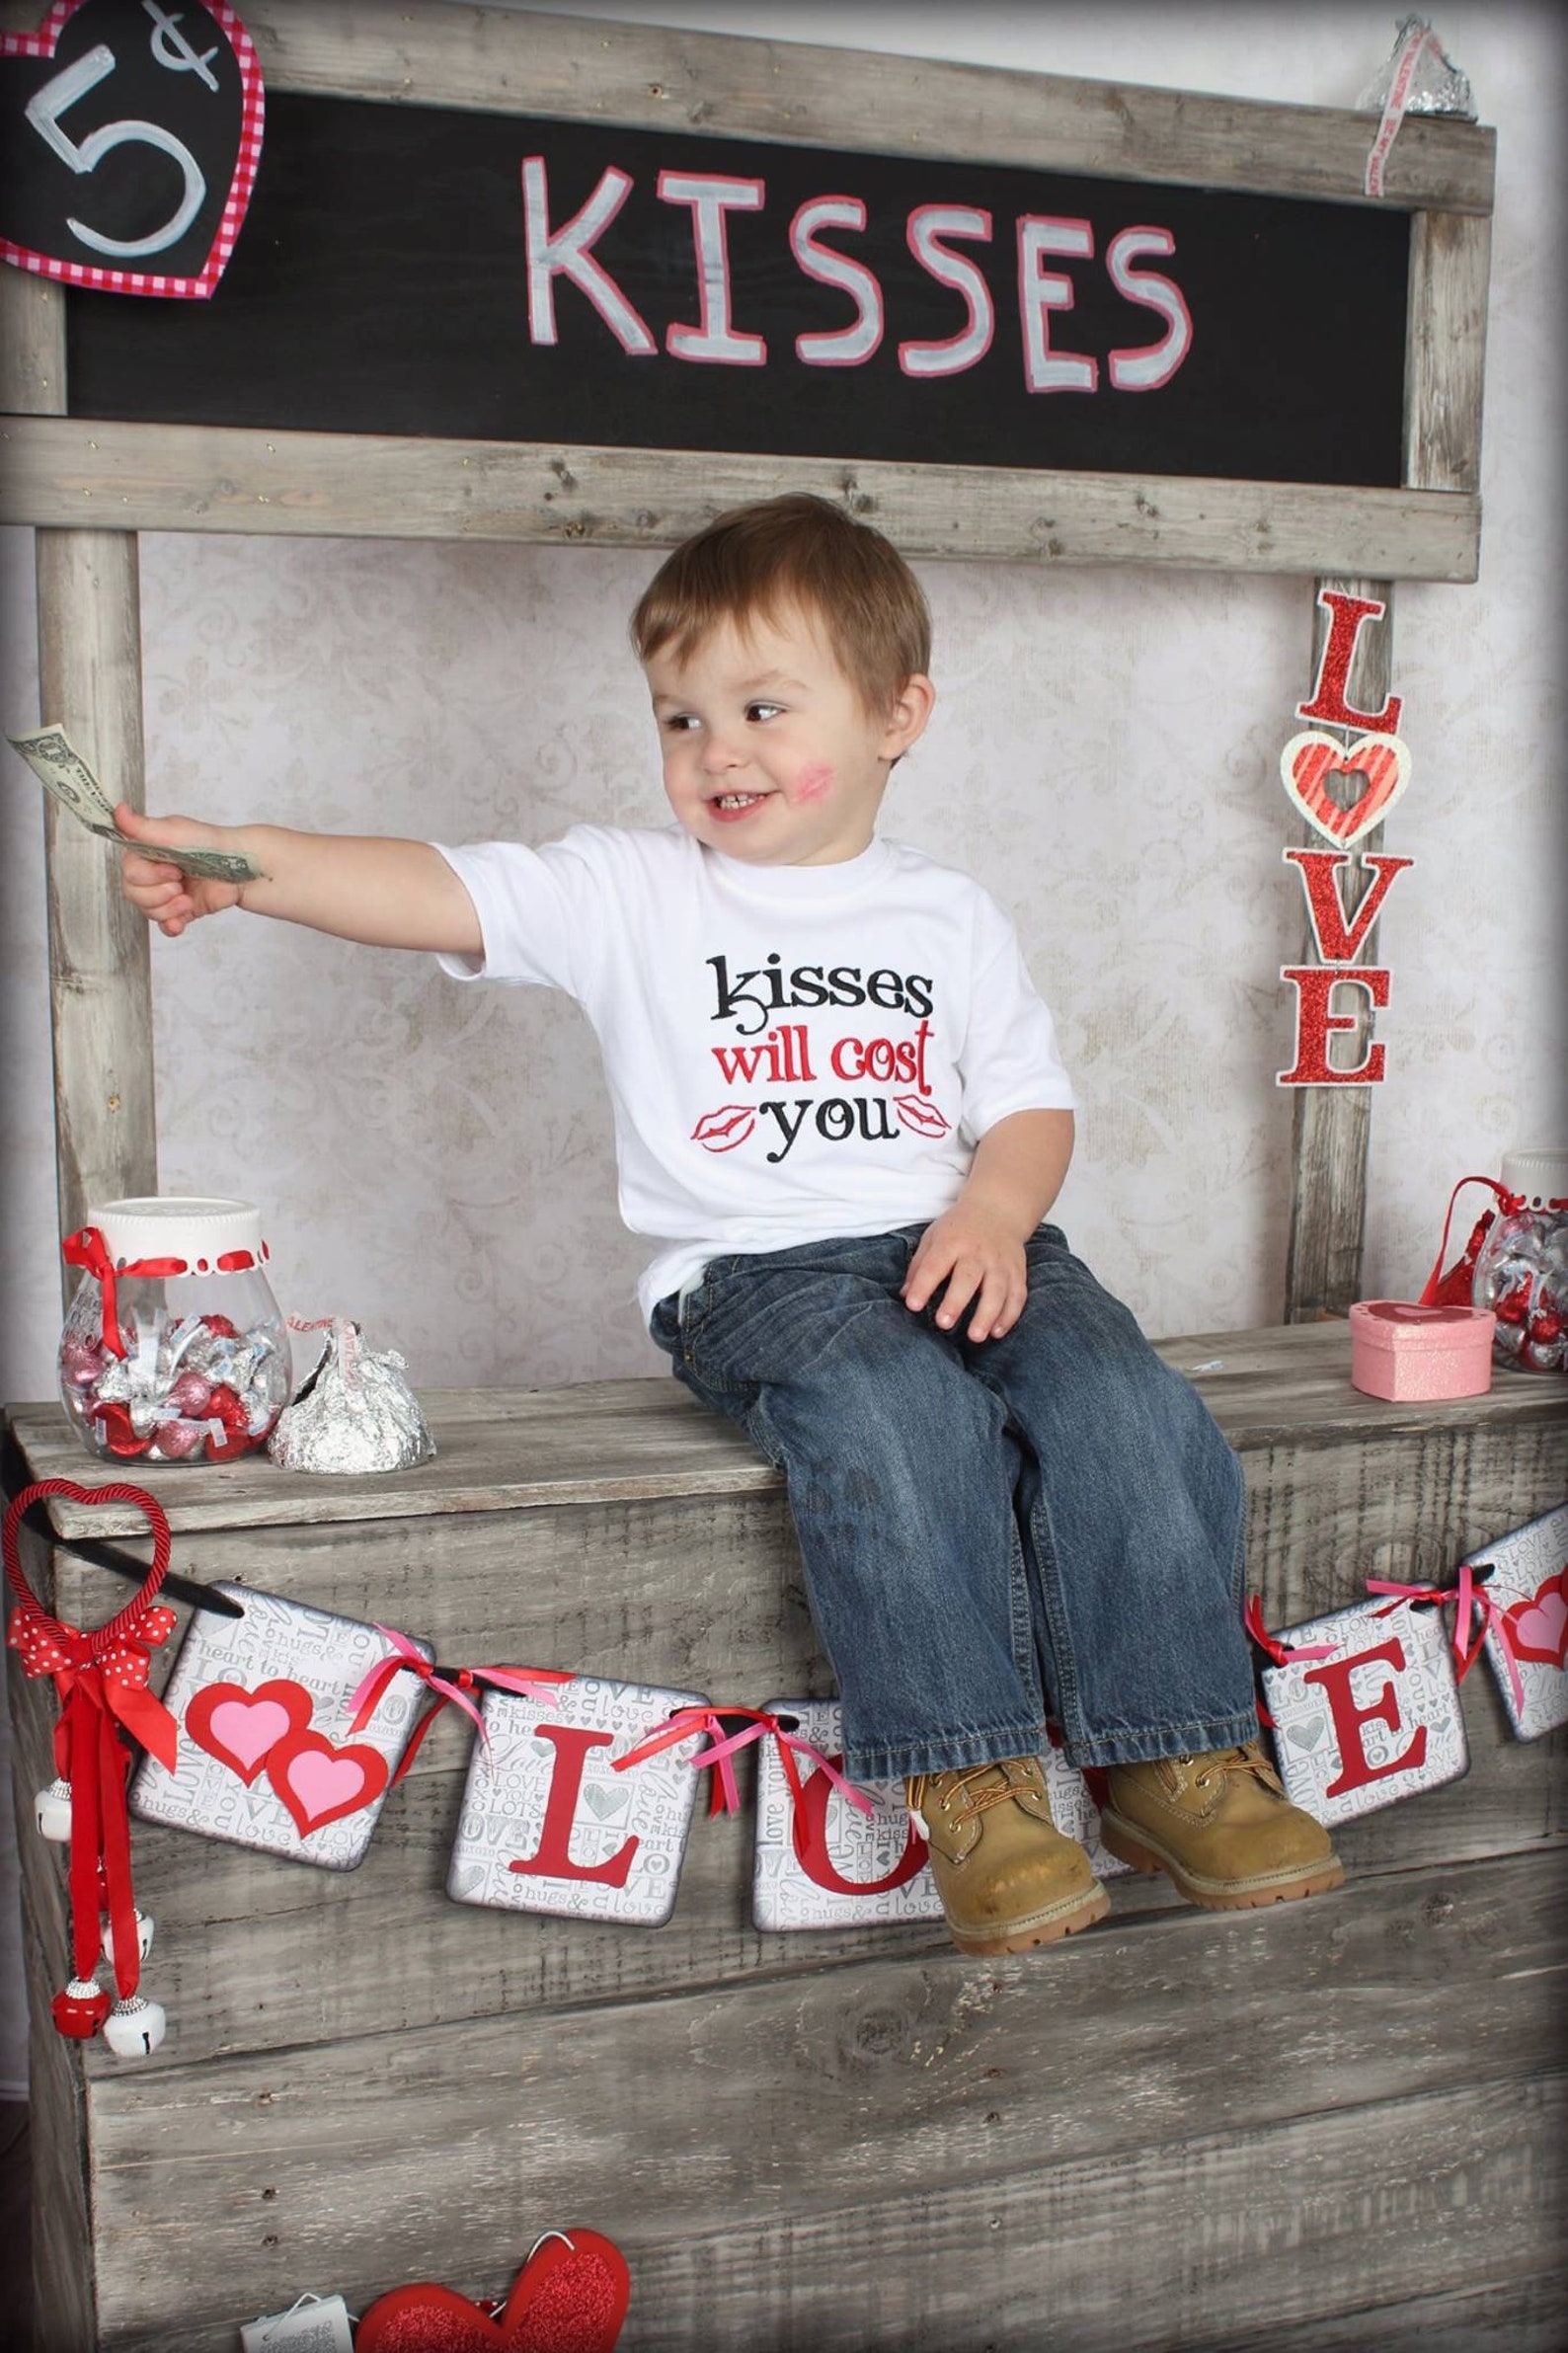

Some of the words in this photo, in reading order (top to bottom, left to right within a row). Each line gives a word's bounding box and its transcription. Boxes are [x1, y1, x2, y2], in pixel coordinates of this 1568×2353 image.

[521, 156, 1193, 393] KISSES
[706, 953, 934, 1035] kisses
[711, 1025, 818, 1085] will
[830, 1020, 935, 1096] cost
[759, 1098, 901, 1163] you
[509, 1723, 640, 1890] L
[1303, 1636, 1428, 1799] E
[878, 1813, 908, 1827] hug
